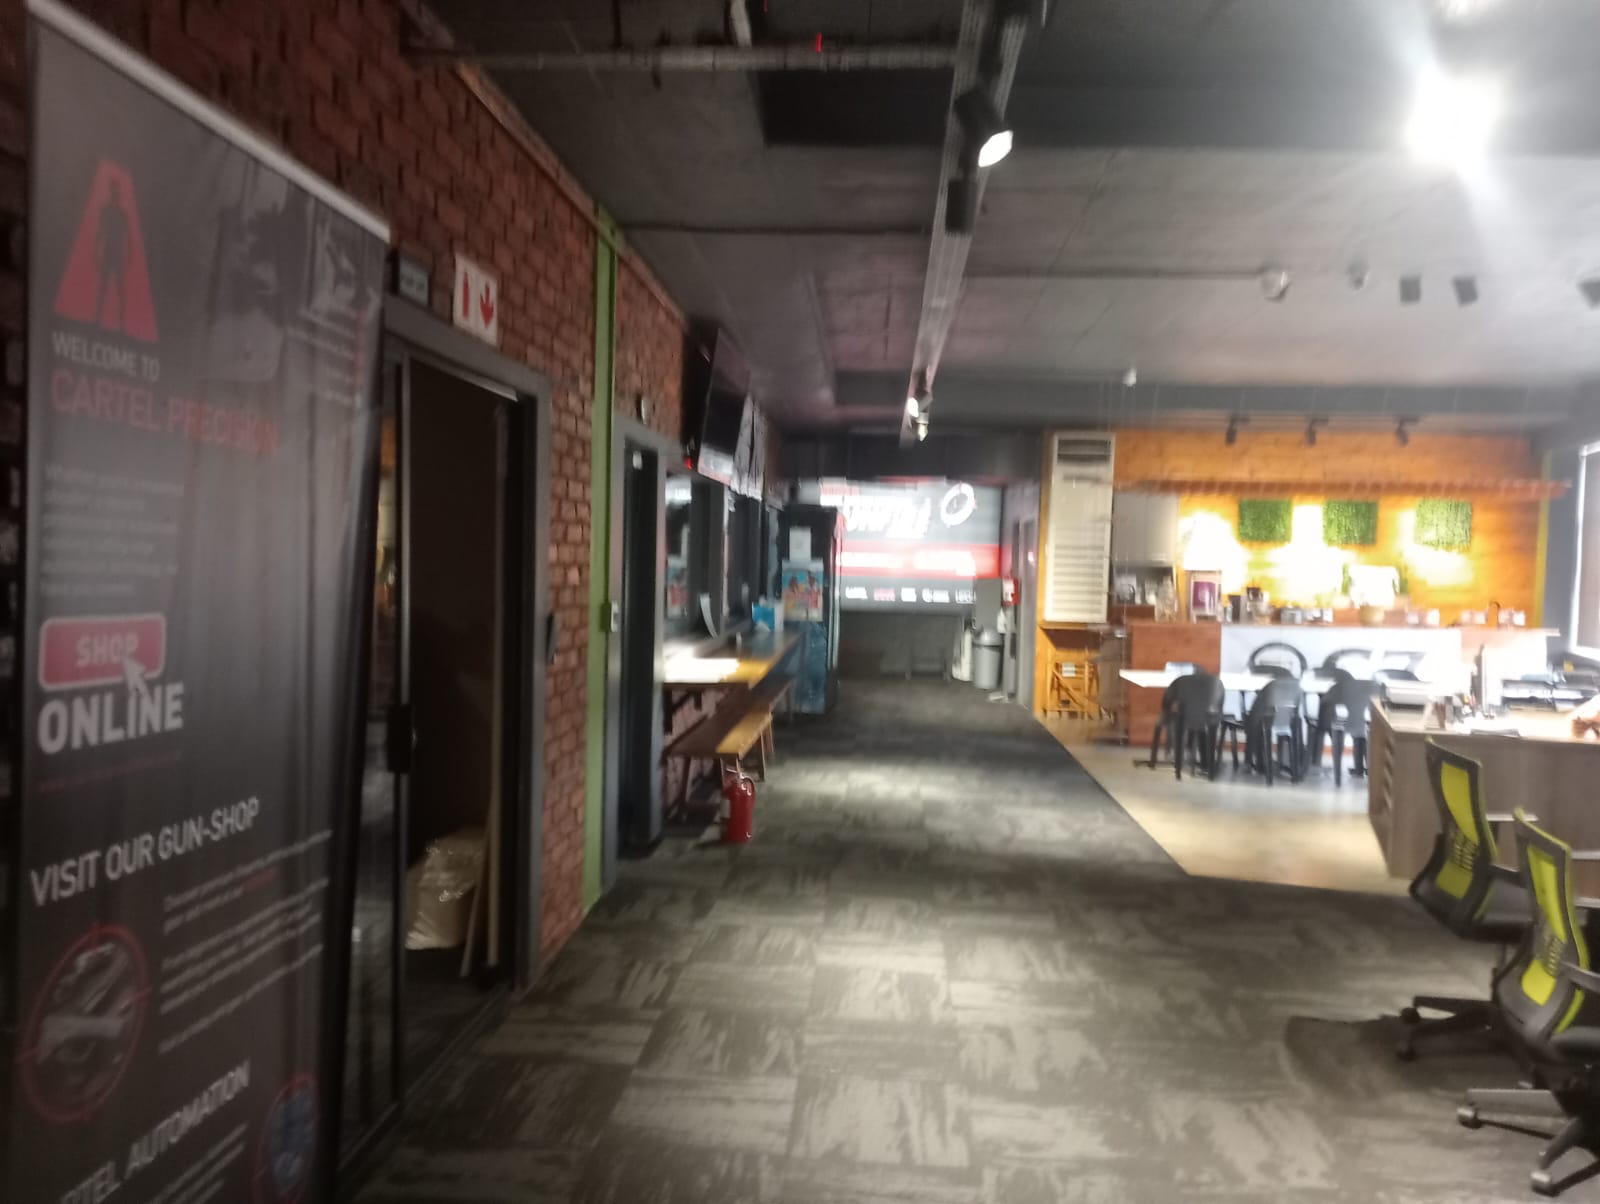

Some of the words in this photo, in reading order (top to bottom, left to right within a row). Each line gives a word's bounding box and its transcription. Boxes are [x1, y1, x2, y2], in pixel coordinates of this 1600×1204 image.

[51, 331, 137, 378] WELCOME
[140, 355, 161, 383] TO
[50, 367, 161, 432] CARTEL
[75, 630, 140, 669] SHOP
[37, 681, 186, 755] ONLINE
[29, 848, 101, 908] VISIT
[105, 832, 156, 882] OUR
[158, 795, 262, 862] GUN-SHOP
